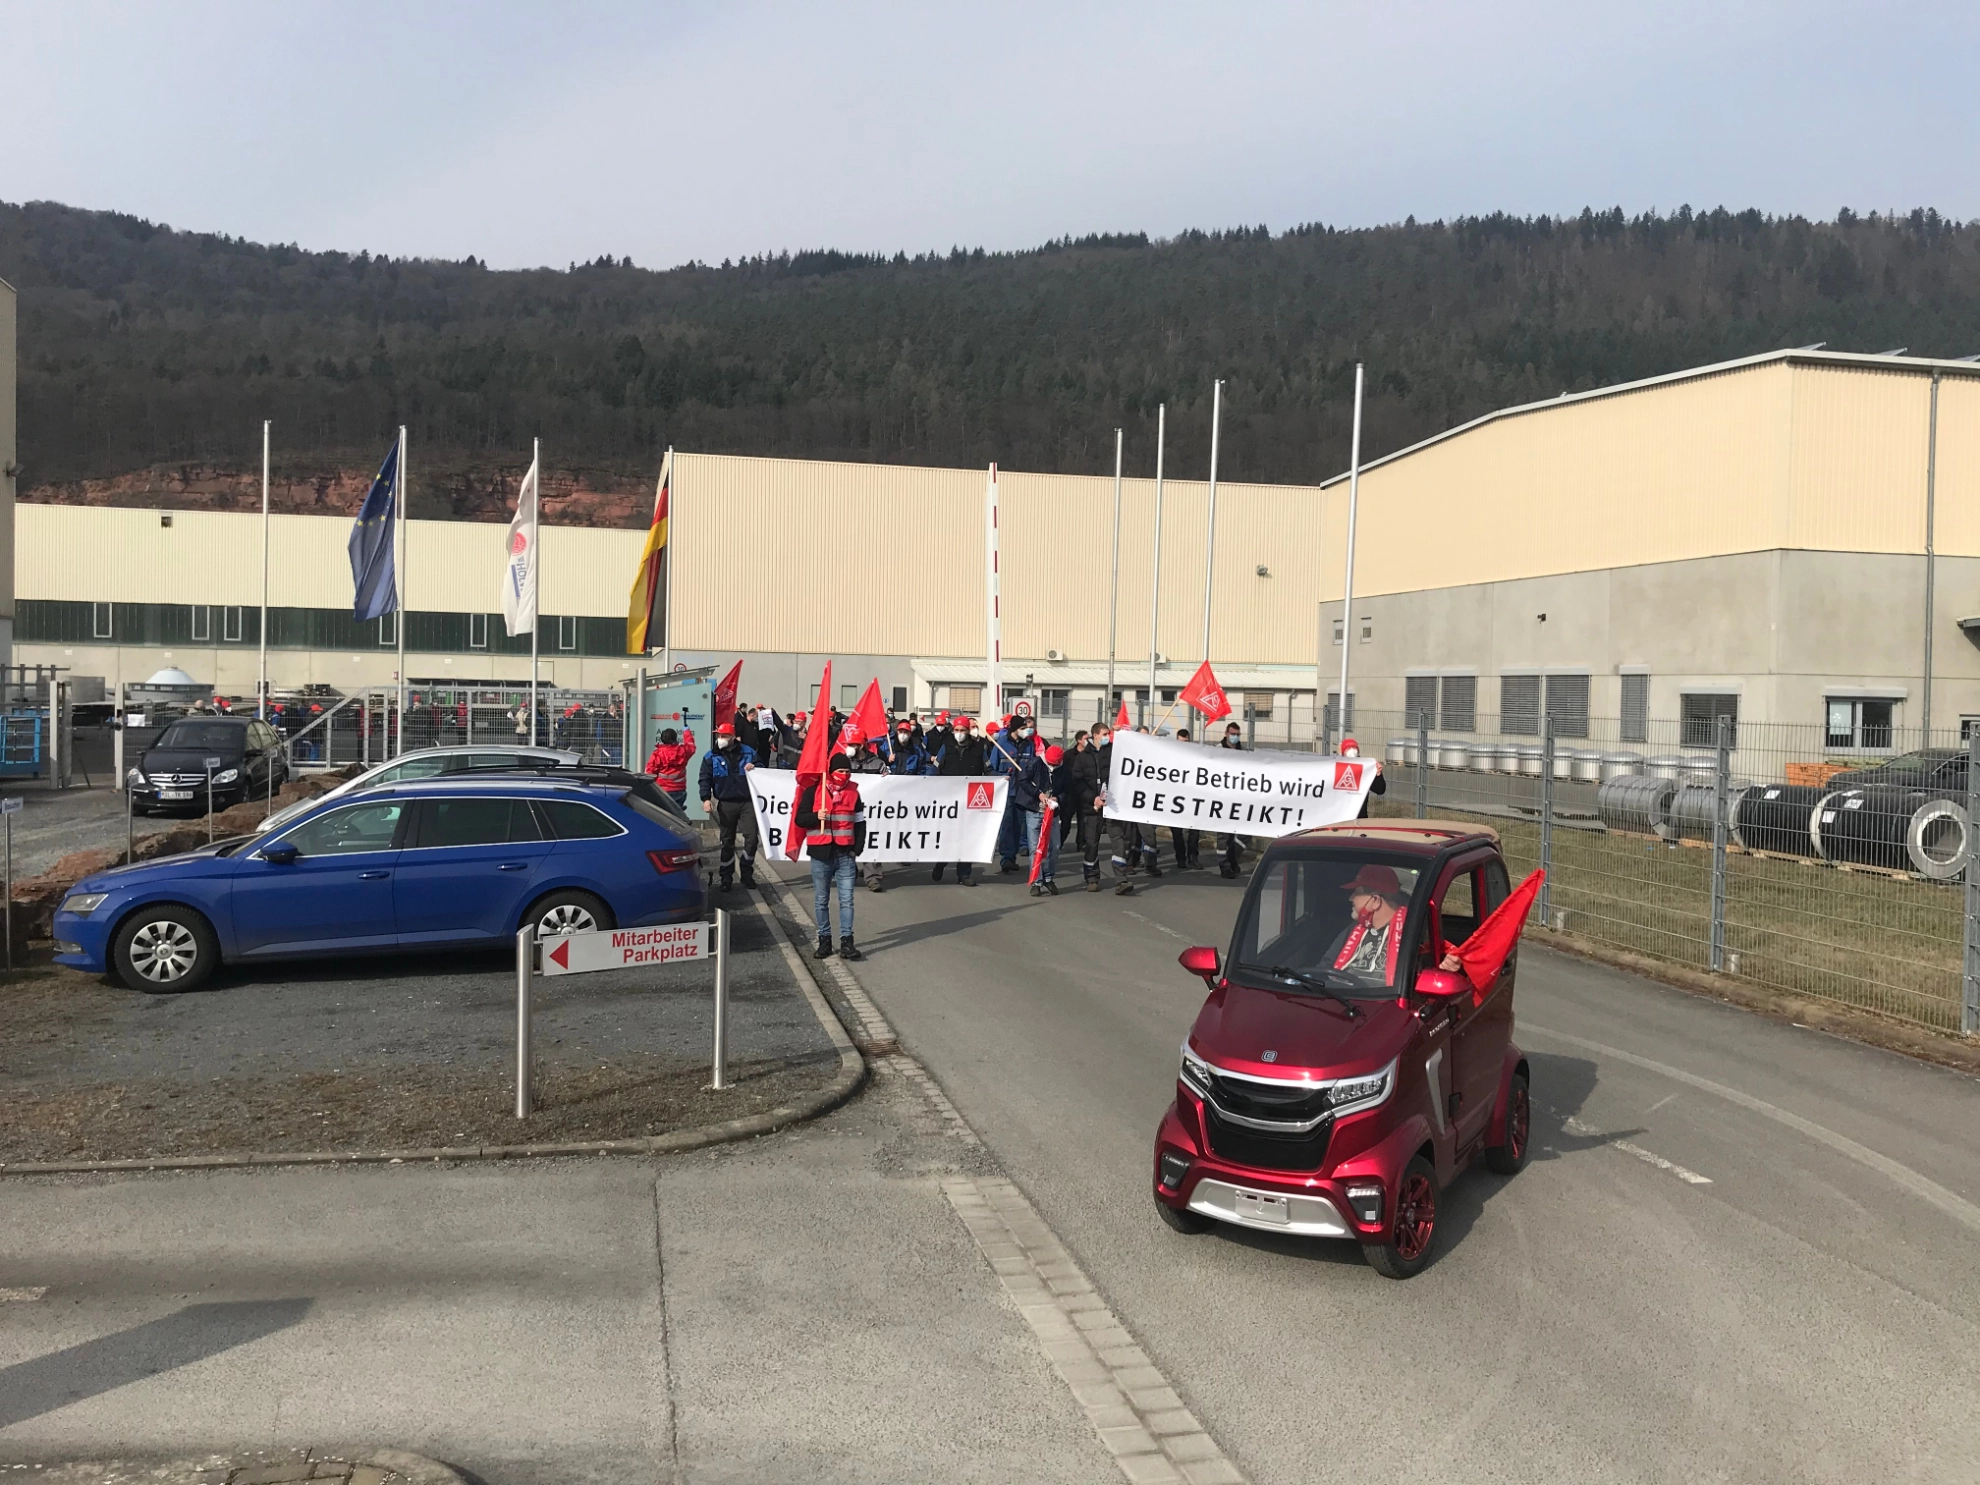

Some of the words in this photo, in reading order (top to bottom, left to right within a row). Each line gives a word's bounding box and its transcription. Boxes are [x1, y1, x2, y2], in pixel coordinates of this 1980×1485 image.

[1018, 706, 1028, 715] 30
[1120, 757, 1190, 784] Dieser
[1196, 767, 1272, 793] Betrieb
[1279, 779, 1325, 799] wird
[915, 800, 959, 819] wird
[1132, 791, 1305, 827] BESTREIKT!
[769, 828, 941, 850] BEIKT!
[612, 927, 699, 948] Mitarbeiter
[623, 943, 698, 964] Parkplatz
